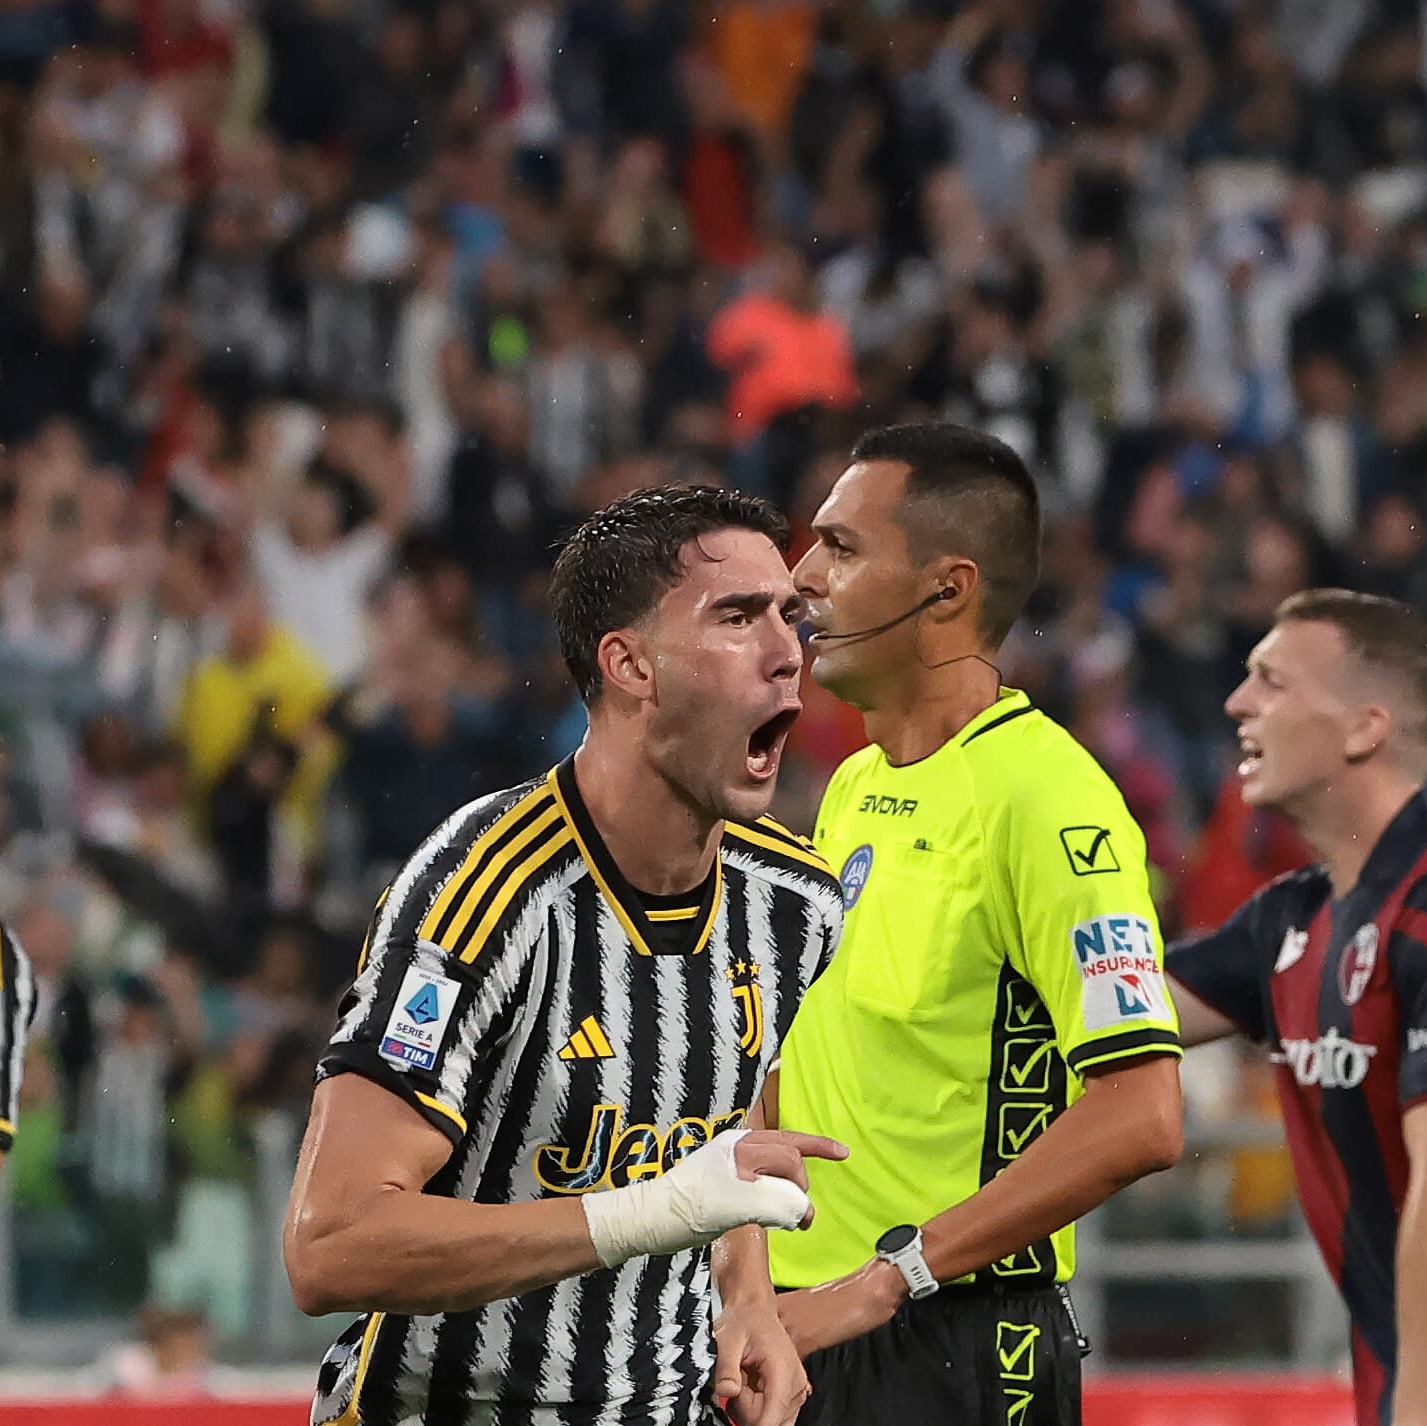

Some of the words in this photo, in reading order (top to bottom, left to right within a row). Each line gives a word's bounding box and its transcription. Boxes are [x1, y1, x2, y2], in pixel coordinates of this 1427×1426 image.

[1074, 919, 1152, 963] NET
[395, 1022, 426, 1039] SERIE
[425, 1033, 433, 1042] A
[403, 1046, 429, 1065] TIM
[532, 1103, 748, 1194] Jee
